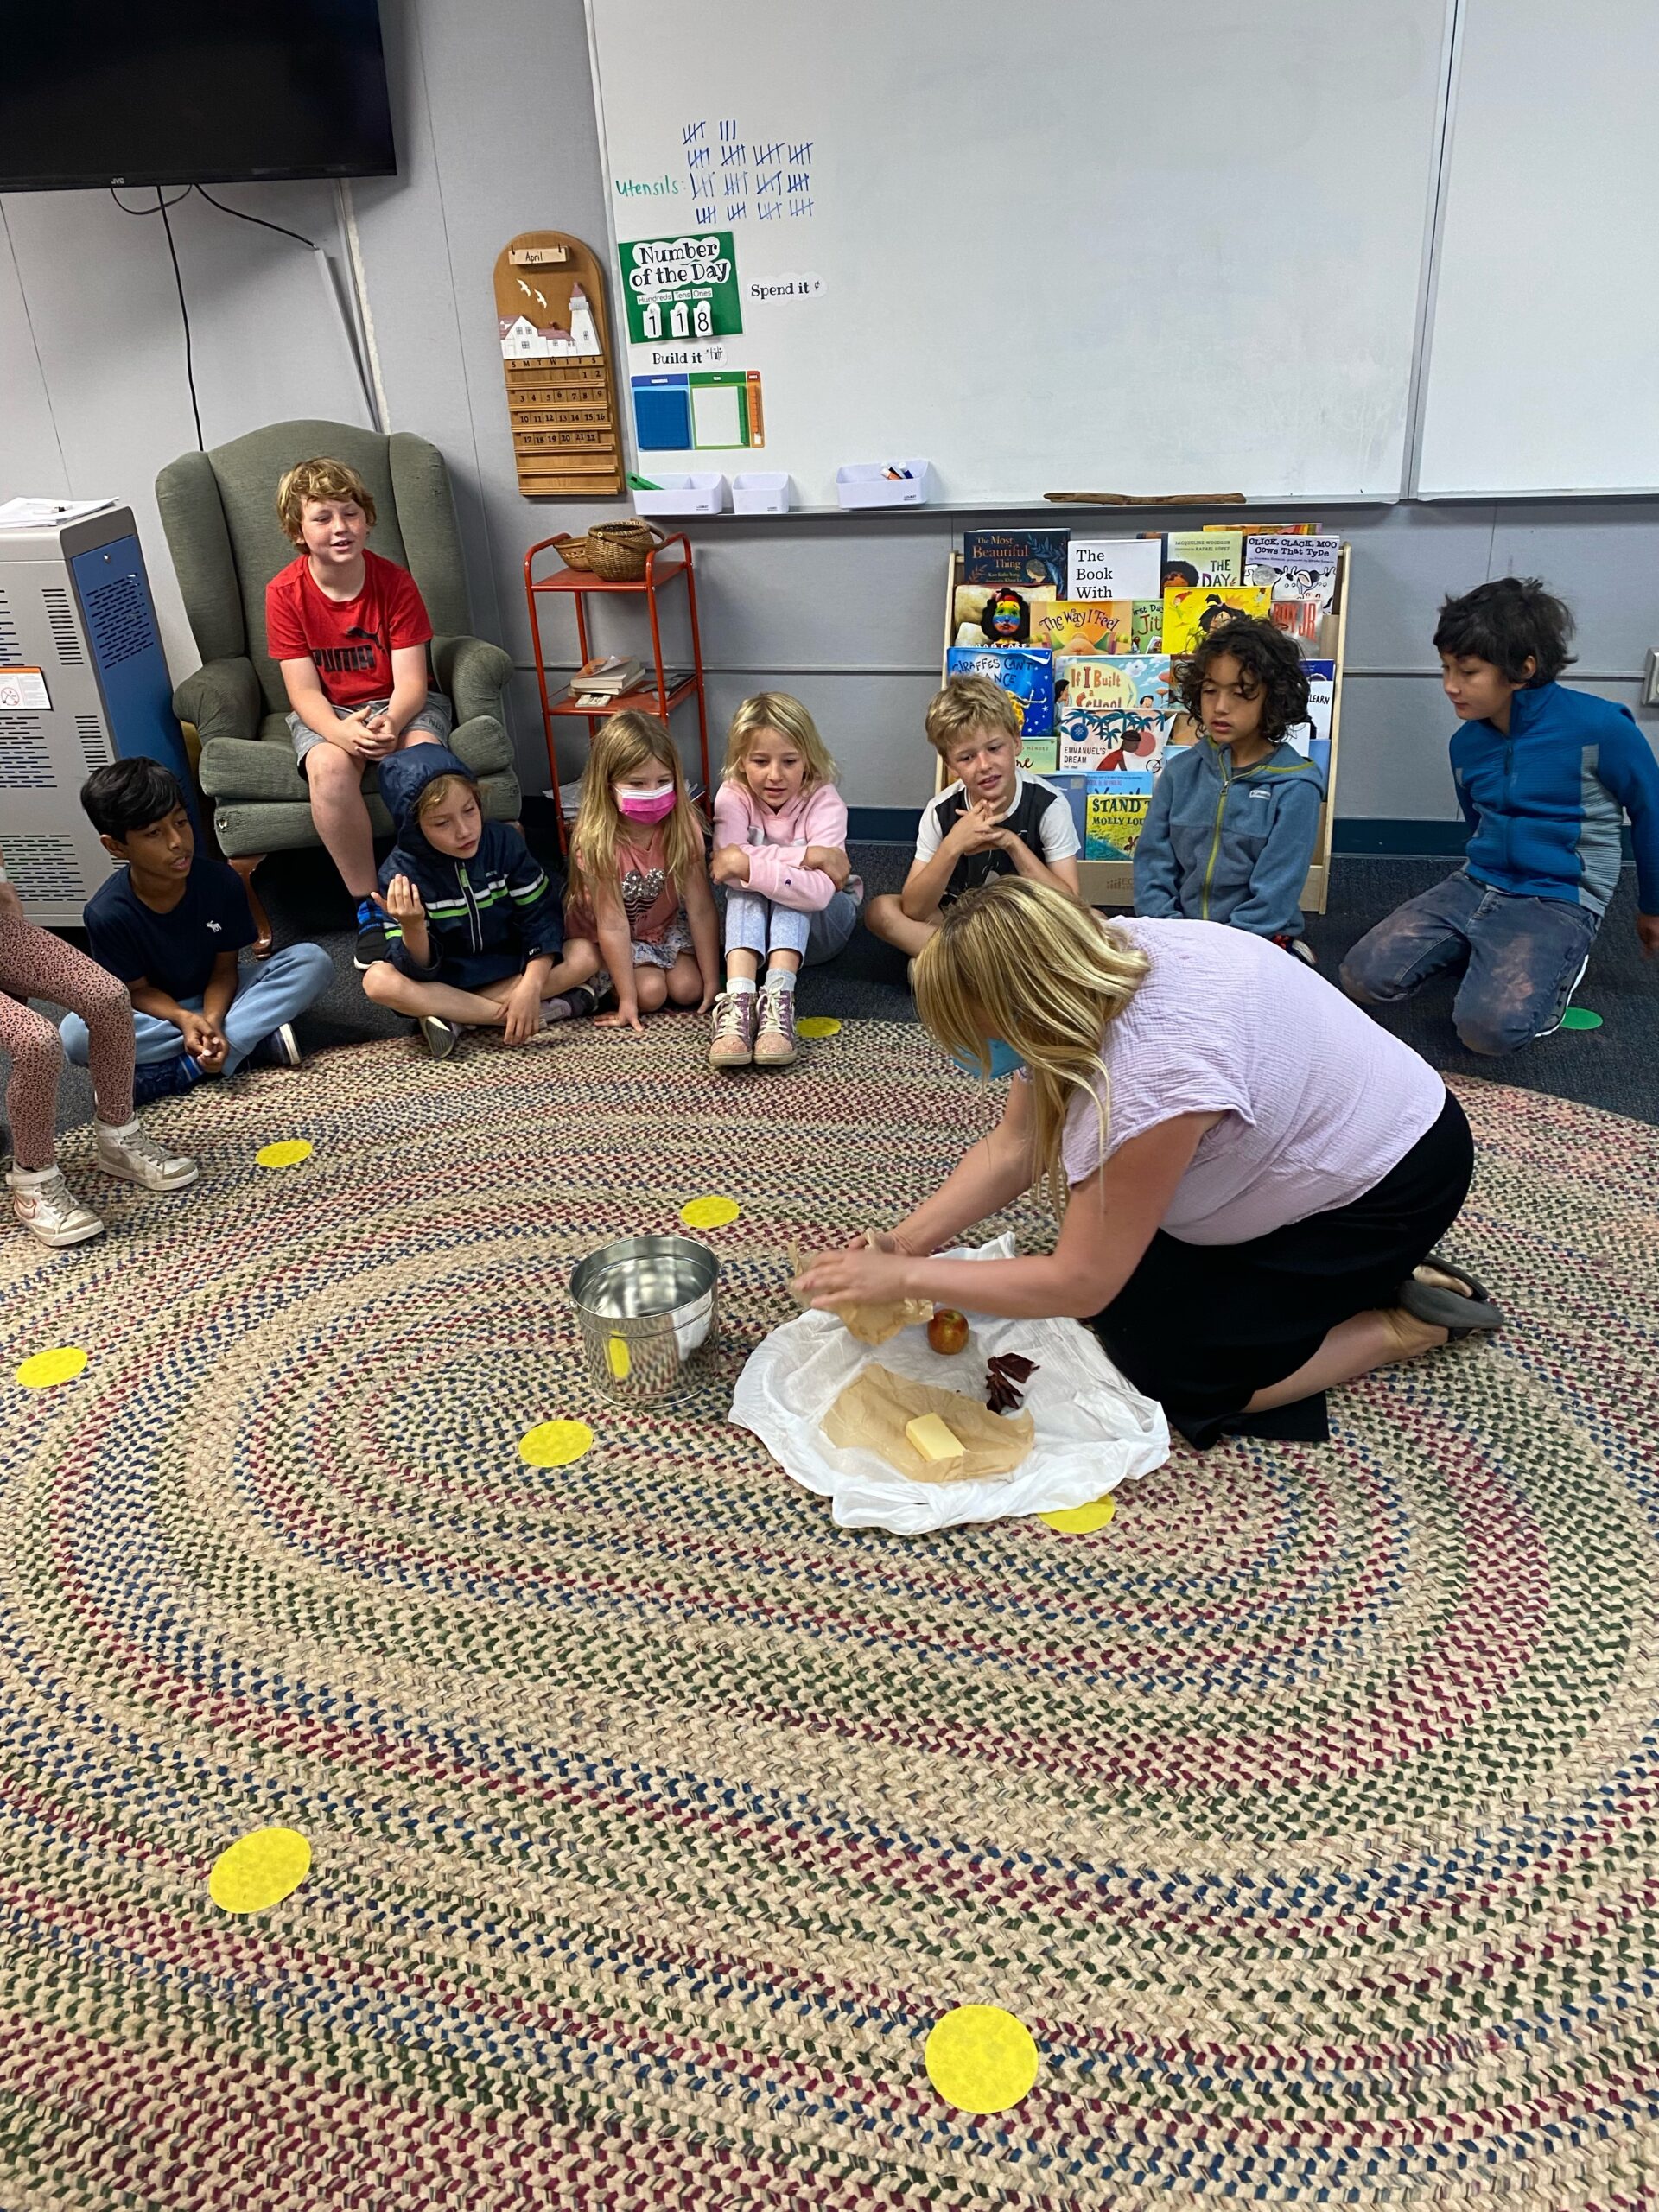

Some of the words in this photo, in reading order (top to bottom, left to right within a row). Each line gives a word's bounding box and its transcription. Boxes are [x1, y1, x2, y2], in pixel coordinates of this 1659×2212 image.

[525, 251, 543, 263] April
[639, 242, 717, 264] Number
[632, 268, 652, 287] of
[656, 267, 687, 284] the
[691, 262, 728, 283] Day
[751, 283, 794, 300] Spend
[798, 282, 809, 294] it
[638, 294, 671, 303] Hundreds
[652, 353, 688, 365] Build
[691, 352, 702, 364] it
[990, 536, 1013, 544] Most
[1316, 540, 1337, 549] MOO
[972, 543, 1029, 558] Beautiful
[1076, 550, 1104, 562] The
[1306, 548, 1329, 557] Type
[995, 558, 1021, 570] Thing
[1211, 559, 1231, 572] THE
[1076, 568, 1113, 580] Book
[1202, 573, 1231, 587] DAY
[1076, 586, 1113, 598] With
[1132, 606, 1147, 616] irst
[1039, 616, 1064, 631] The
[1063, 608, 1086, 628] Way
[1087, 608, 1093, 623] I
[1094, 609, 1120, 632] Feel
[1137, 614, 1162, 635] Jit
[312, 645, 375, 672] PUMA
[1071, 668, 1081, 688] If
[1084, 666, 1091, 688] I
[1094, 669, 1121, 688] Built
[1309, 694, 1330, 705] LEARN
[1064, 746, 1106, 755] EMMANUEL'S
[1064, 755, 1087, 764] DREAM
[1092, 798, 1141, 813] STAND
[1092, 817, 1124, 825] MOLLY
